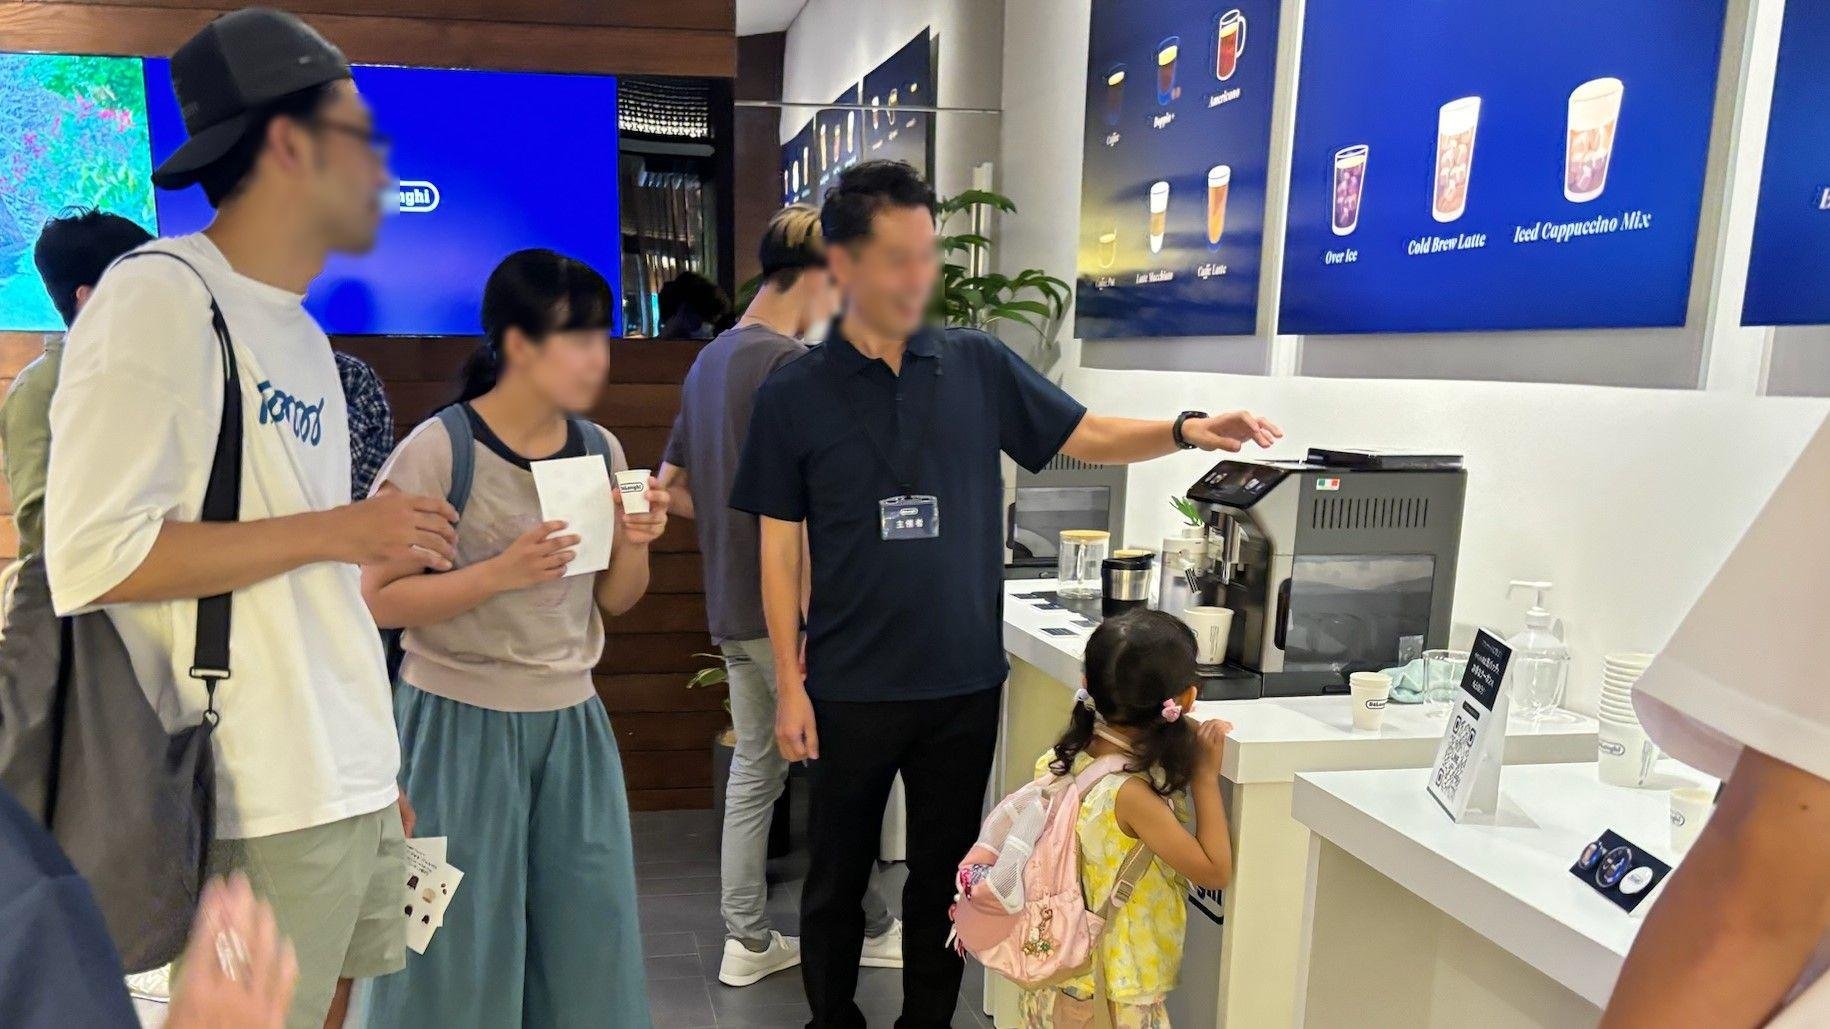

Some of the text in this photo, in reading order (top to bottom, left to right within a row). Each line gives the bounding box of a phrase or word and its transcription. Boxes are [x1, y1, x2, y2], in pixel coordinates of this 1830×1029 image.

[400, 188, 430, 207] nghi
[1513, 210, 1652, 243] Iced Cappuccino Mix
[1408, 233, 1487, 255] Cold Brew Latte
[1325, 248, 1358, 264] Over Ice
